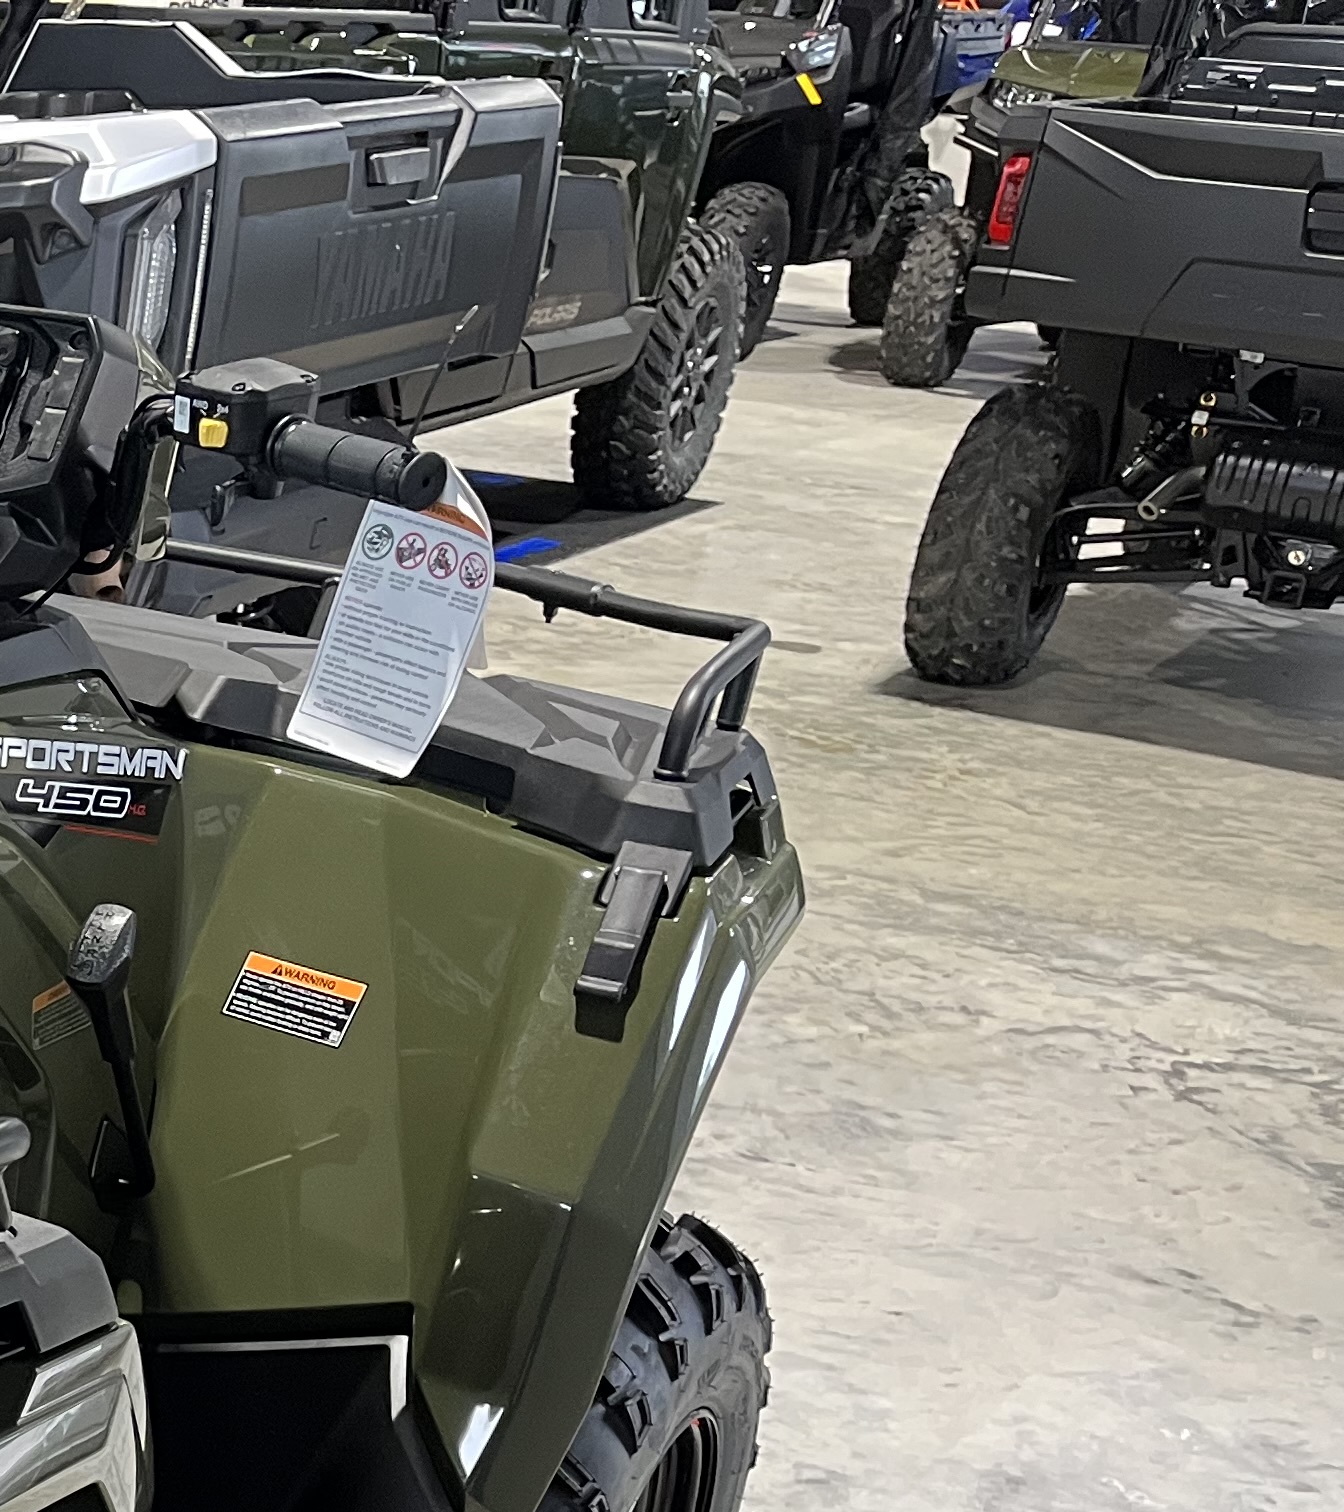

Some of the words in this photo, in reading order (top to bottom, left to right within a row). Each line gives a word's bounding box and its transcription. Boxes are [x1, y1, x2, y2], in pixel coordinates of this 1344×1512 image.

[310, 209, 457, 330] YAMAHA
[15, 777, 131, 819] 450
[284, 966, 337, 991] WARNING
